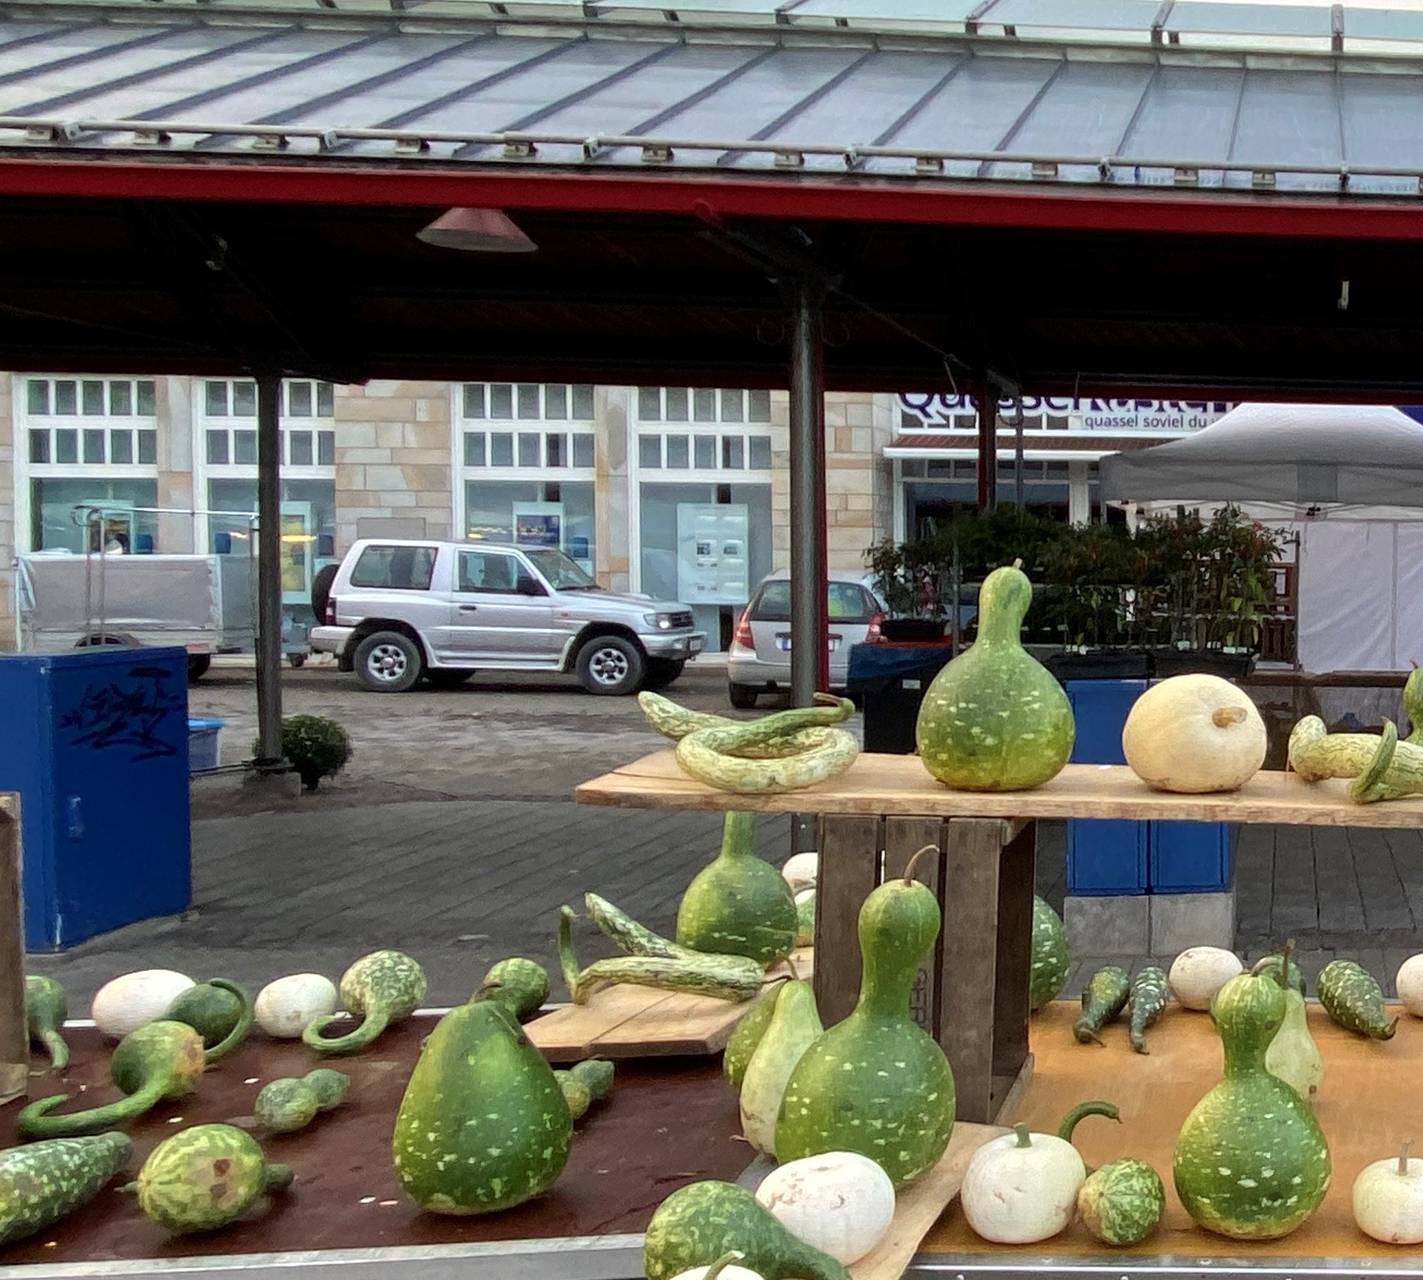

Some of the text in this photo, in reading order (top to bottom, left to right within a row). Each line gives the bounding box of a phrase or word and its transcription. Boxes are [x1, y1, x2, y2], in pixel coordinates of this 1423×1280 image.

[1084, 415, 1138, 428] quassel
[1143, 415, 1184, 428] soviel
[1188, 415, 1207, 428] du
